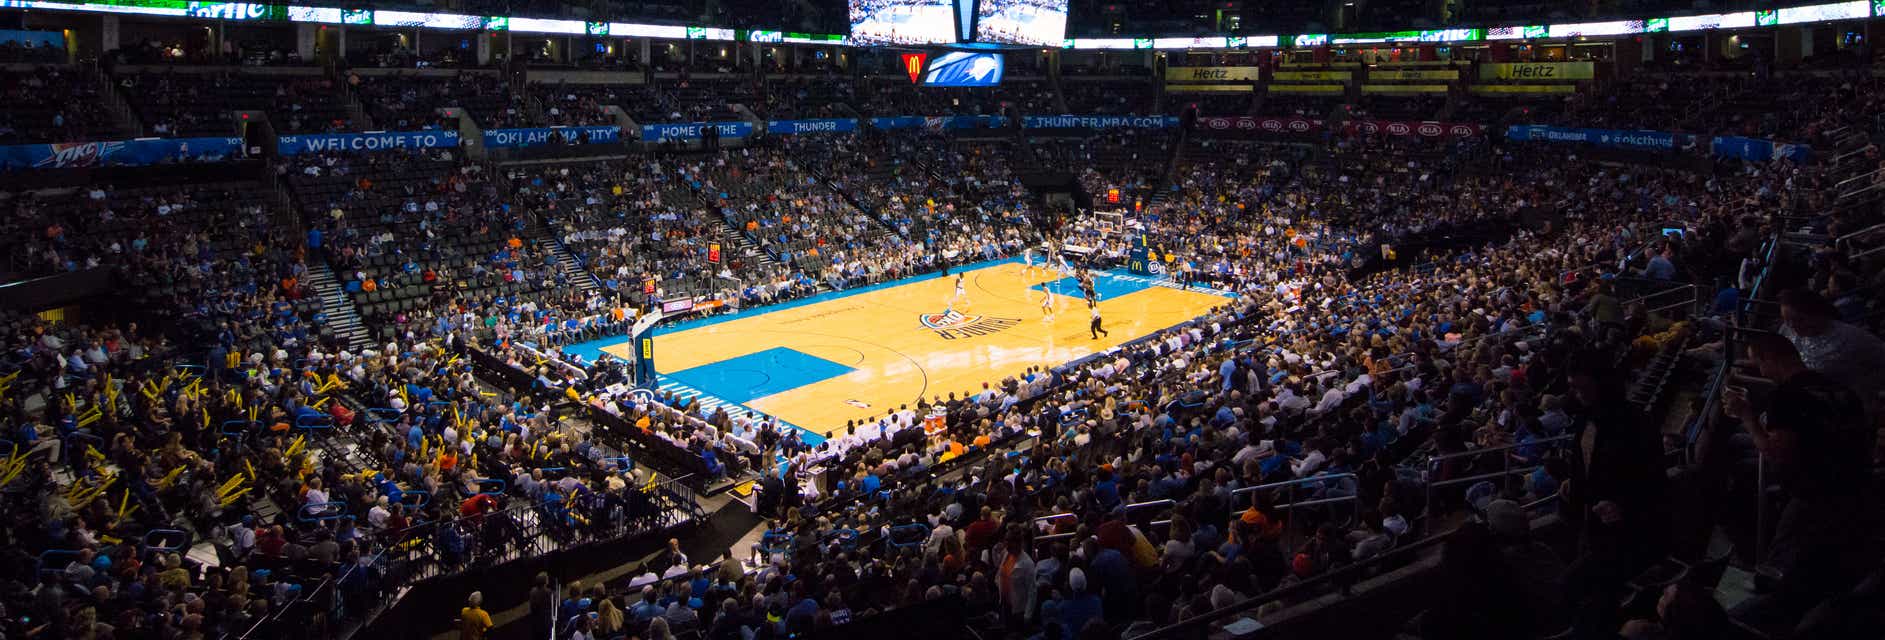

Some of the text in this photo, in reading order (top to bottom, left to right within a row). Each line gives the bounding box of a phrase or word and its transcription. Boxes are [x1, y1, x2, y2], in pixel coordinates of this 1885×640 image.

[1193, 68, 1228, 79] Hertz
[1512, 64, 1555, 78] Hertz
[661, 125, 696, 137] HOME
[793, 121, 837, 132] THUNDER
[280, 136, 297, 144] 104
[443, 130, 458, 139] 104
[306, 134, 437, 152] WELCOME TO
